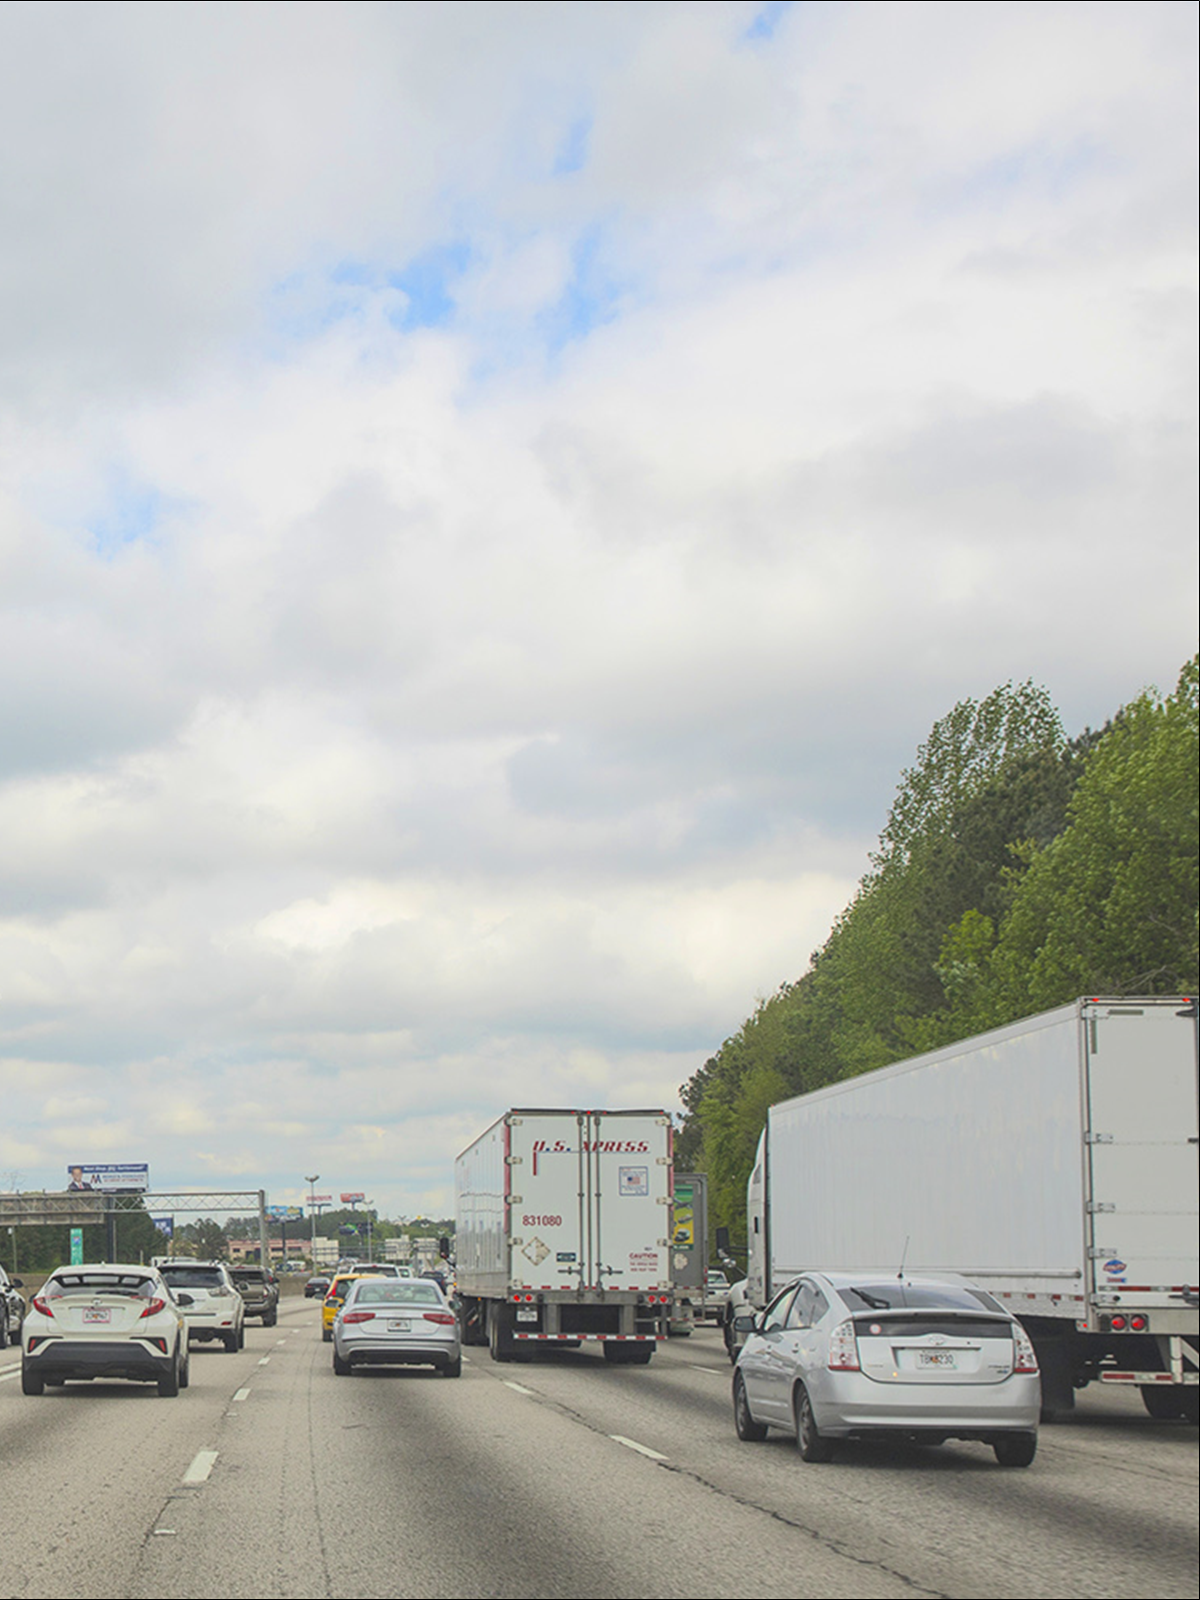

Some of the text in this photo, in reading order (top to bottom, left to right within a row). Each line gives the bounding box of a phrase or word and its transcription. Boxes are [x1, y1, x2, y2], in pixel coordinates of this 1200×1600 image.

[533, 1140, 649, 1152] U.S. XPRESS
[522, 1215, 562, 1226] 831080
